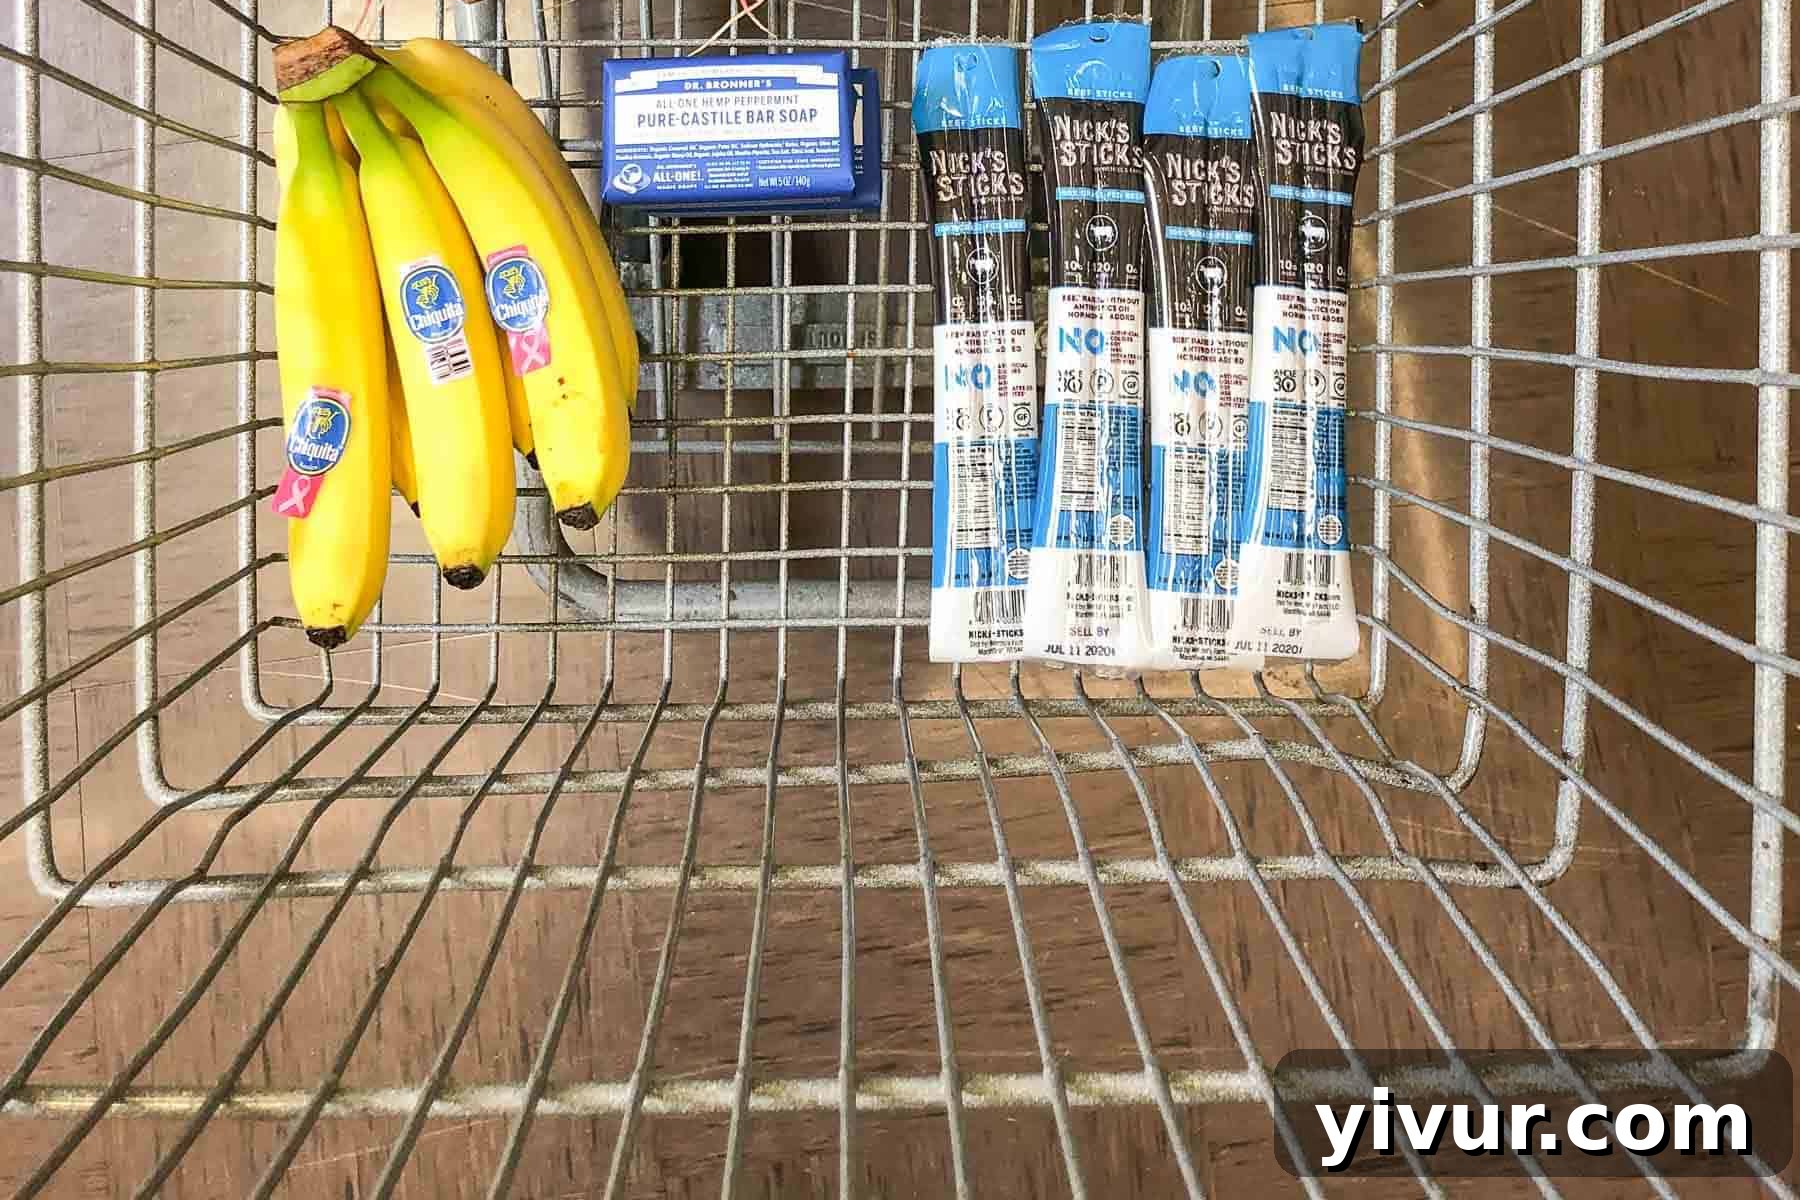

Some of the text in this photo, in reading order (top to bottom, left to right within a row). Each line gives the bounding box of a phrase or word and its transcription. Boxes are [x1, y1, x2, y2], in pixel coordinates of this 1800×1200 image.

[684, 79, 773, 90] DR. BRONNER'S
[1095, 89, 1133, 98] STICKS
[702, 96, 730, 108] HEMP
[734, 94, 799, 106] PEPPERMINT
[637, 107, 818, 128] PURE-CASTILE BAR SOAP
[1053, 113, 1130, 144] NICK'S
[1270, 112, 1342, 144] NICK'S
[929, 147, 1006, 176] NICK'S
[1059, 140, 1144, 168] STICKS
[1166, 152, 1241, 183] NICK'S
[1276, 139, 1357, 170] STICKS
[653, 168, 702, 183] ALL-ONE!
[936, 171, 1025, 202] STICKS
[1171, 180, 1254, 208] STICKS
[495, 293, 546, 321] Chiqu
[1107, 296, 1139, 305] ITHOUT
[410, 302, 464, 331] Chiquita
[1058, 327, 1105, 355] NO
[289, 435, 341, 462] Chiquita
[1070, 624, 1110, 638] SELL BY
[1288, 627, 1302, 638] BY
[1044, 644, 1065, 656] JUL
[1069, 645, 1081, 657] 11
[1234, 640, 1254, 652] JUL
[1256, 640, 1269, 653] 11
